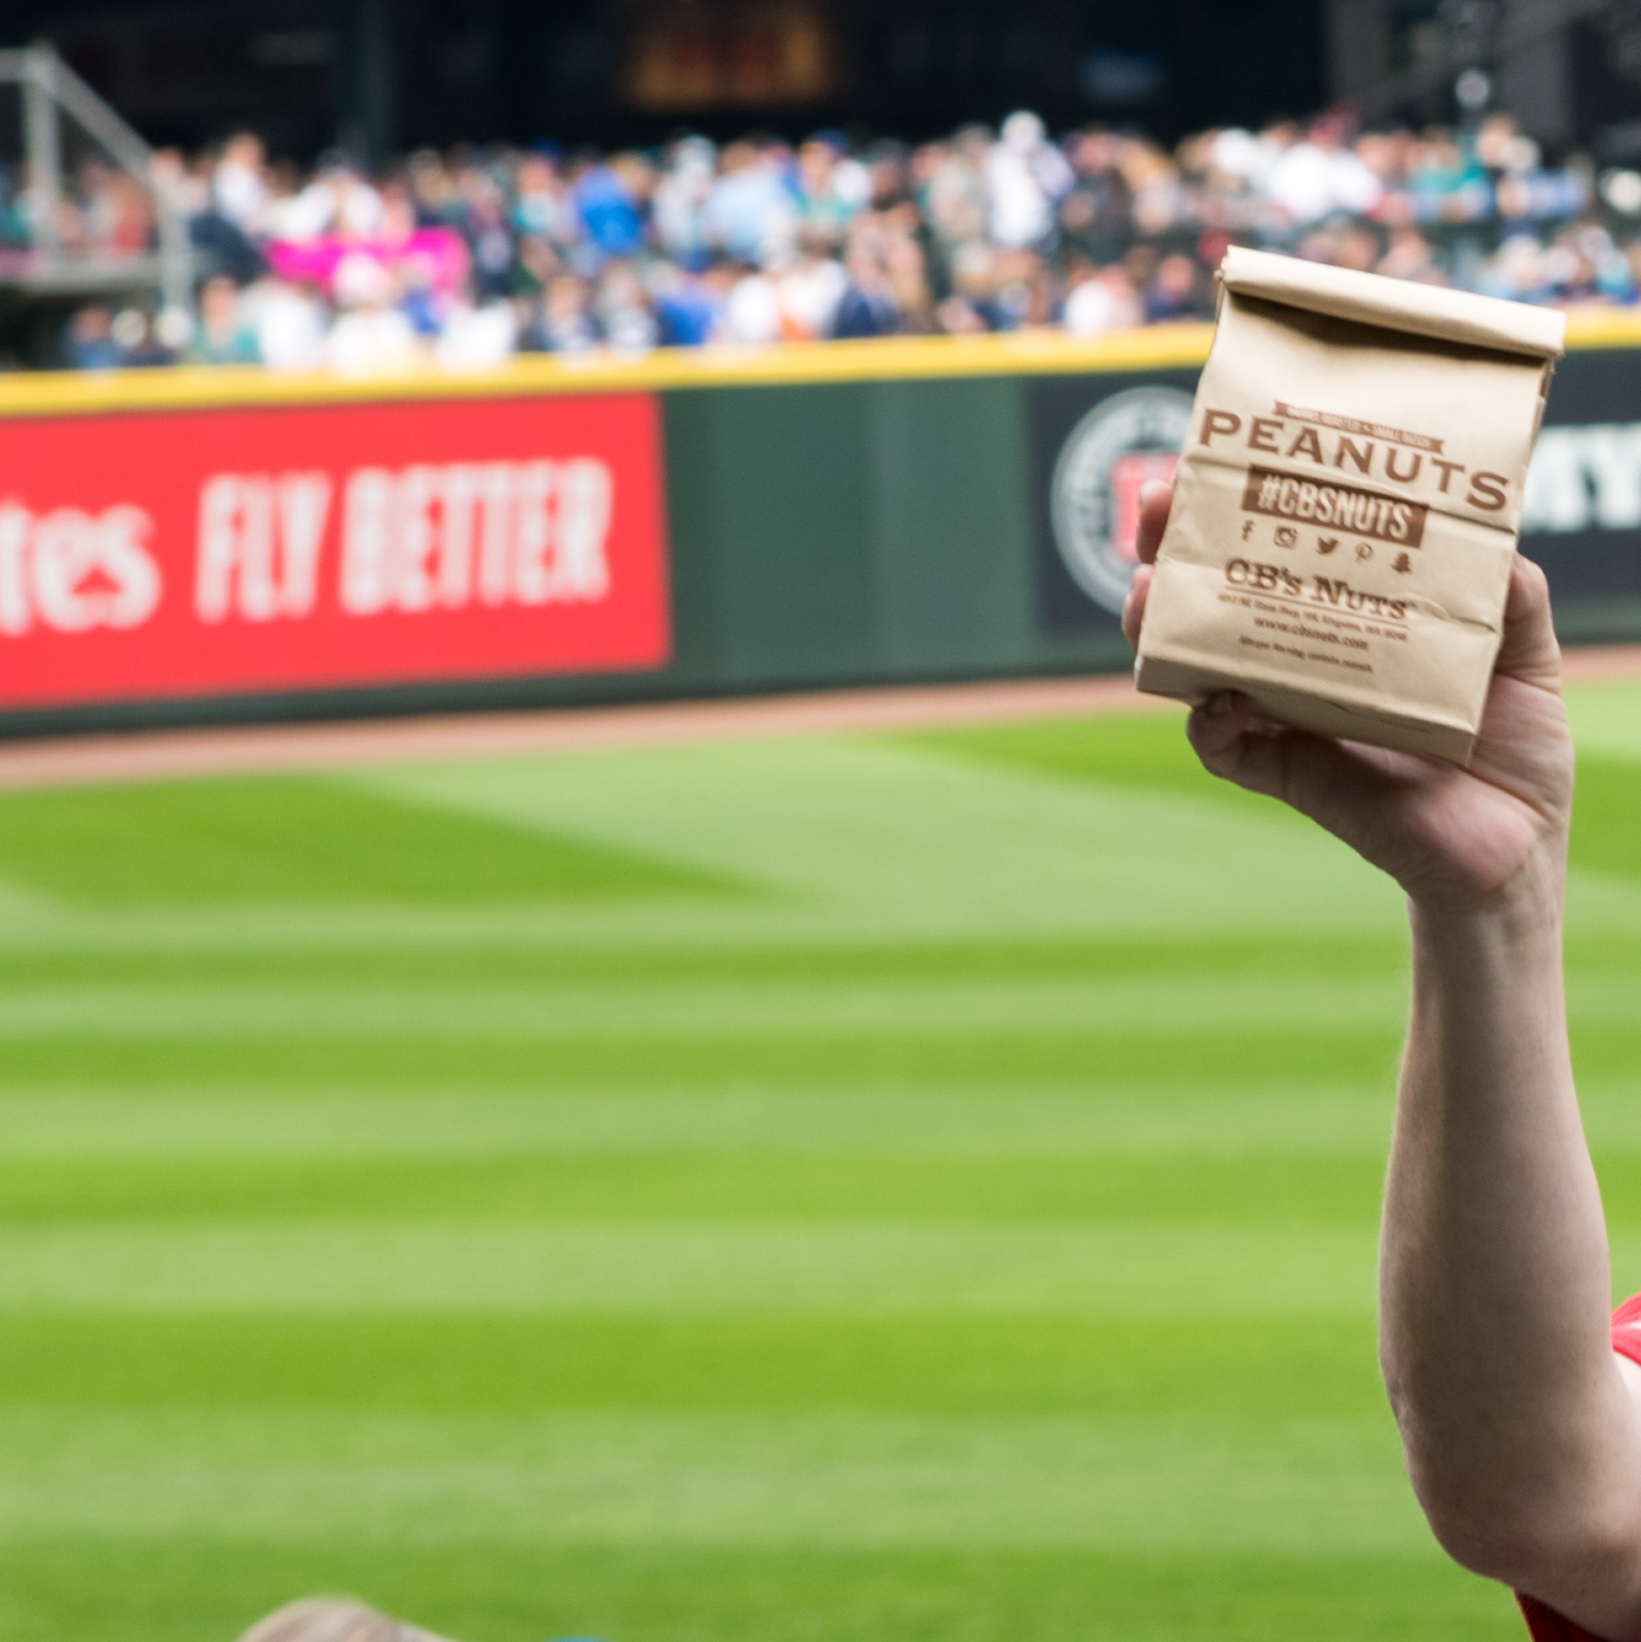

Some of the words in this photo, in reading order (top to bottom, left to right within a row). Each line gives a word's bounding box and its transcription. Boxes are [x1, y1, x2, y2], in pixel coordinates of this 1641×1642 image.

[1198, 408, 1510, 512] PEANUTS
[1256, 472, 1414, 538] #CBSNUTS
[195, 473, 332, 622] FLY
[340, 457, 613, 614] BETTER
